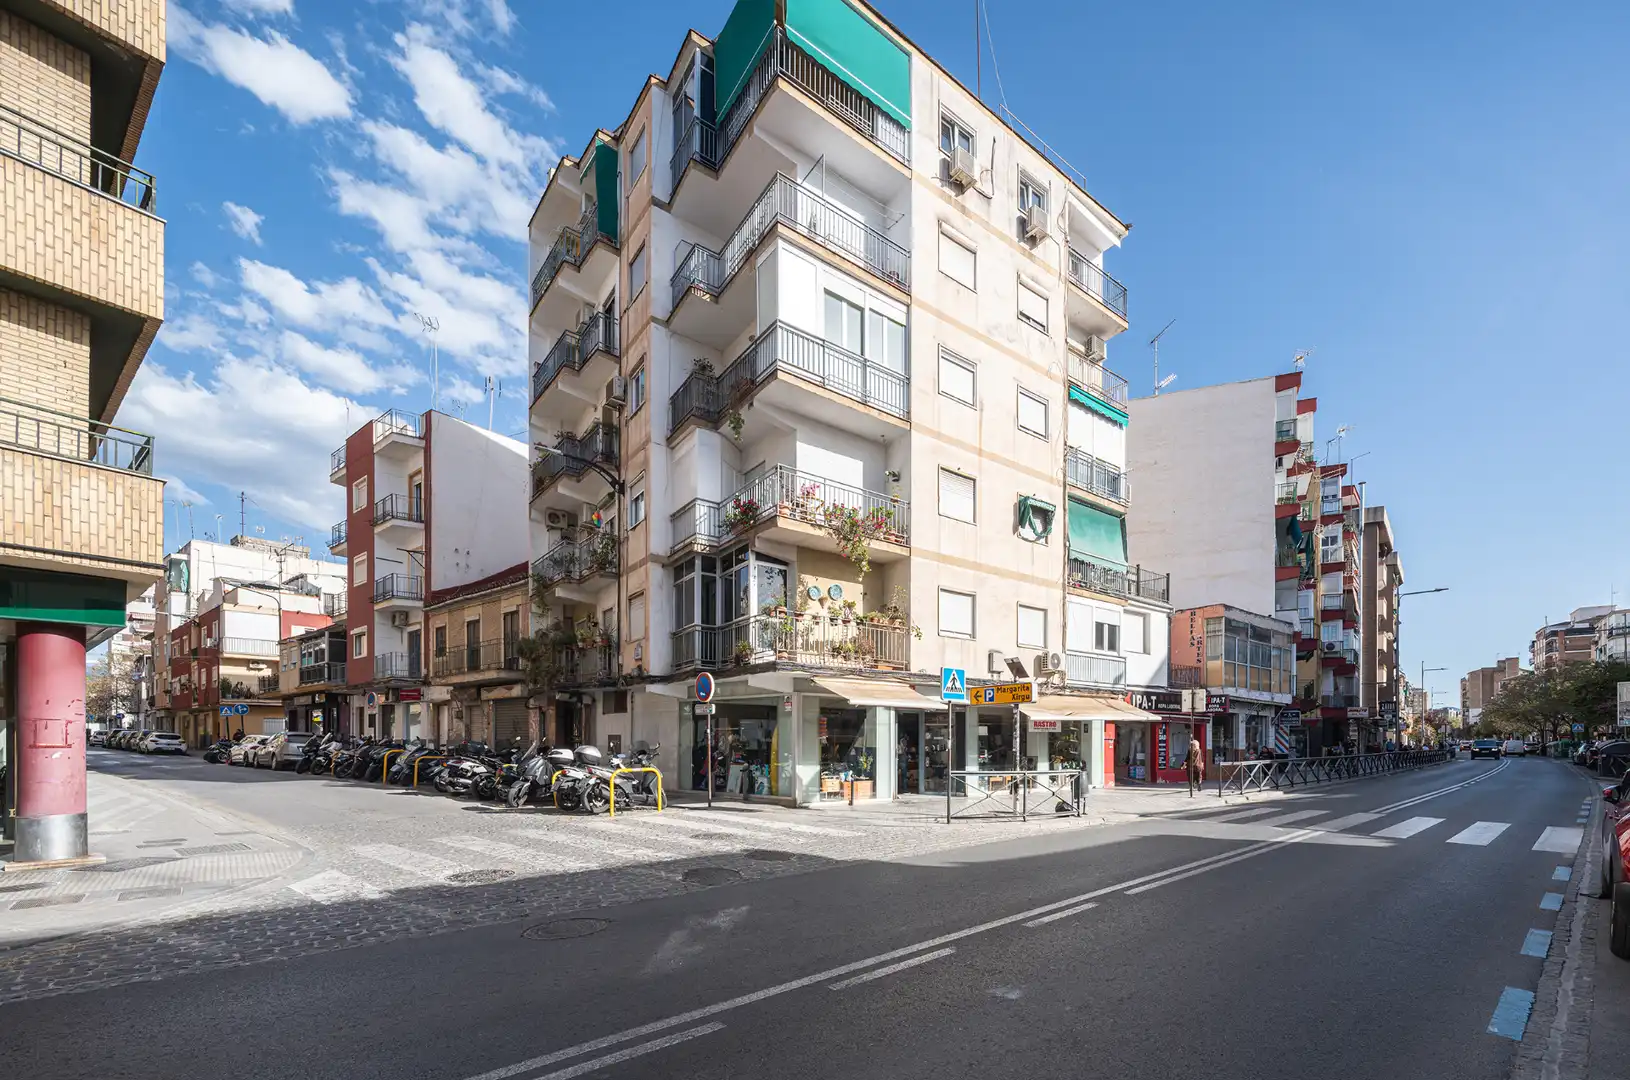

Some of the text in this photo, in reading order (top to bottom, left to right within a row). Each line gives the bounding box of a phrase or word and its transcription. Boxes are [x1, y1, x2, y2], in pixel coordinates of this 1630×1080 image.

[997, 686, 1029, 694] Margarita
[1012, 693, 1030, 702] Xirgu
[1033, 720, 1057, 728] RASTRO
